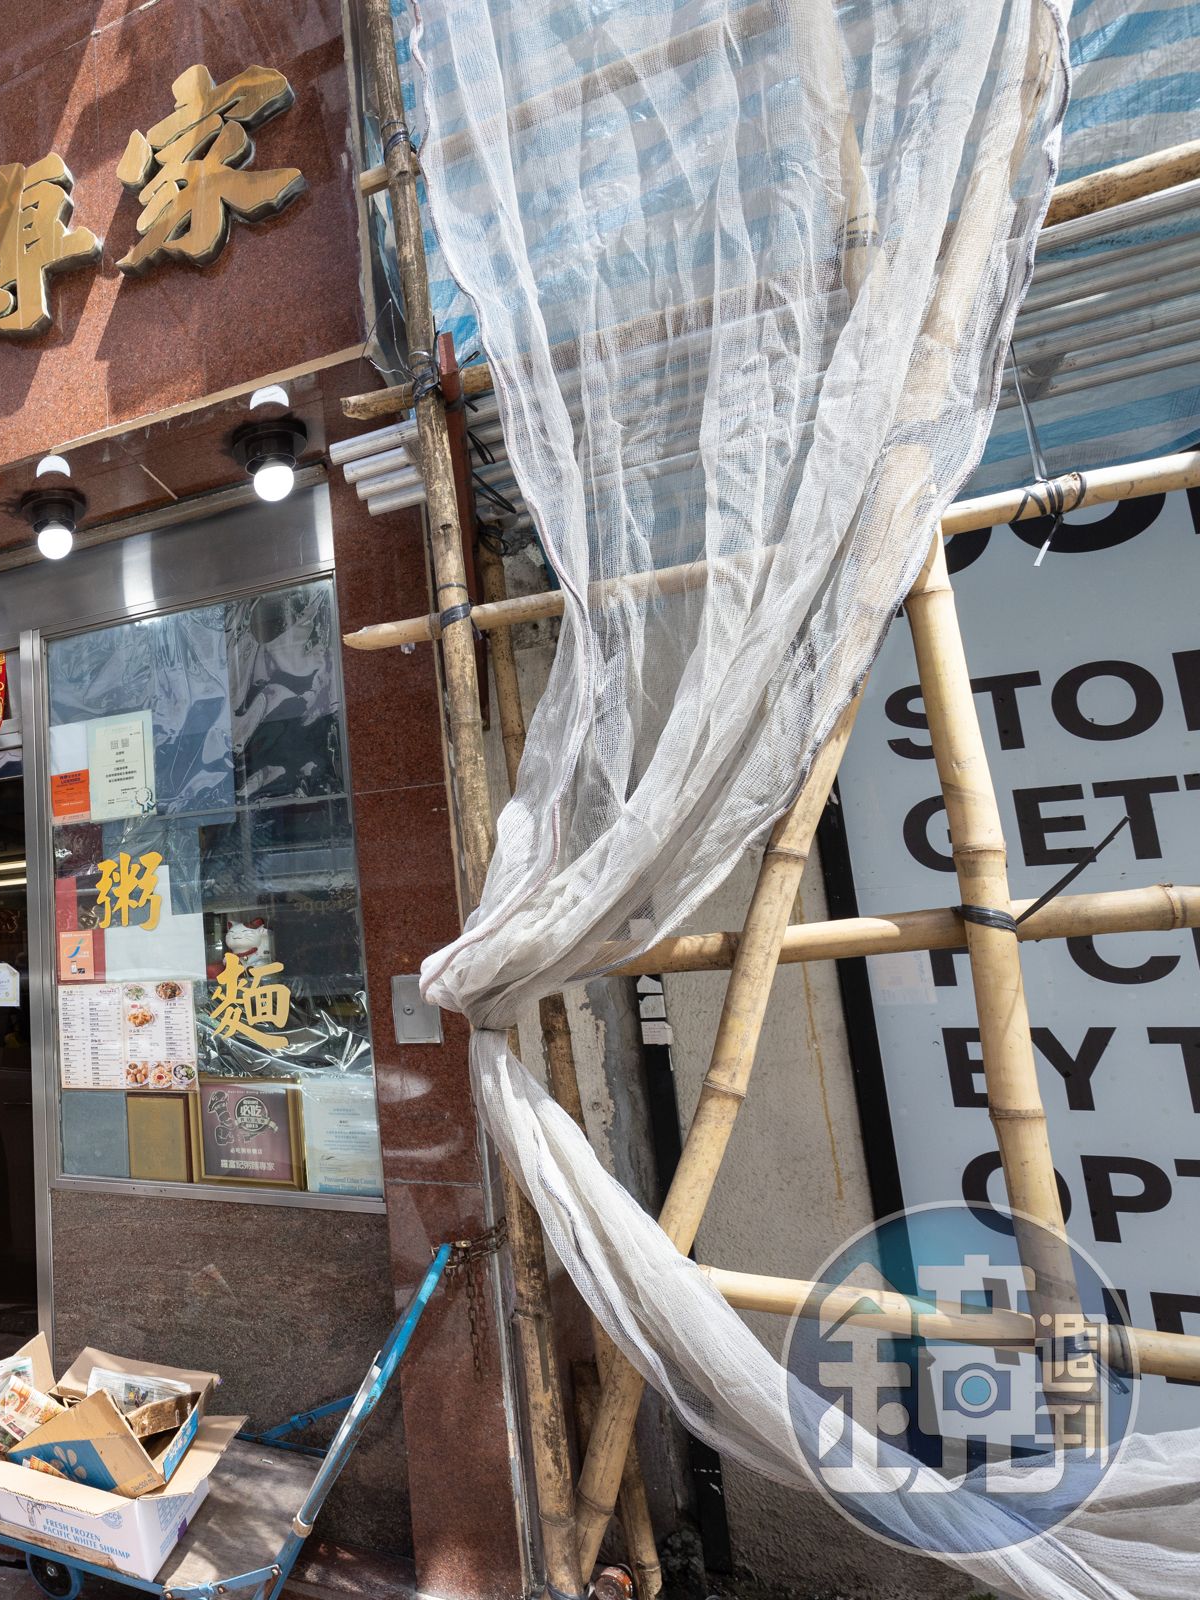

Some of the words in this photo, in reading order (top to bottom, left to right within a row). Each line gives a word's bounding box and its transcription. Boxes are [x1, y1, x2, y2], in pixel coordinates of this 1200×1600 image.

[902, 773, 1200, 873] GET
[96, 852, 163, 930] 粥
[210, 952, 291, 1050] 麵
[43, 1525, 72, 1541] PACIFIC
[72, 1534, 98, 1549] WHITE
[99, 1543, 131, 1560] SHRIMP
[45, 1518, 69, 1532] FRESH
[70, 1526, 101, 1543] FROZEN
